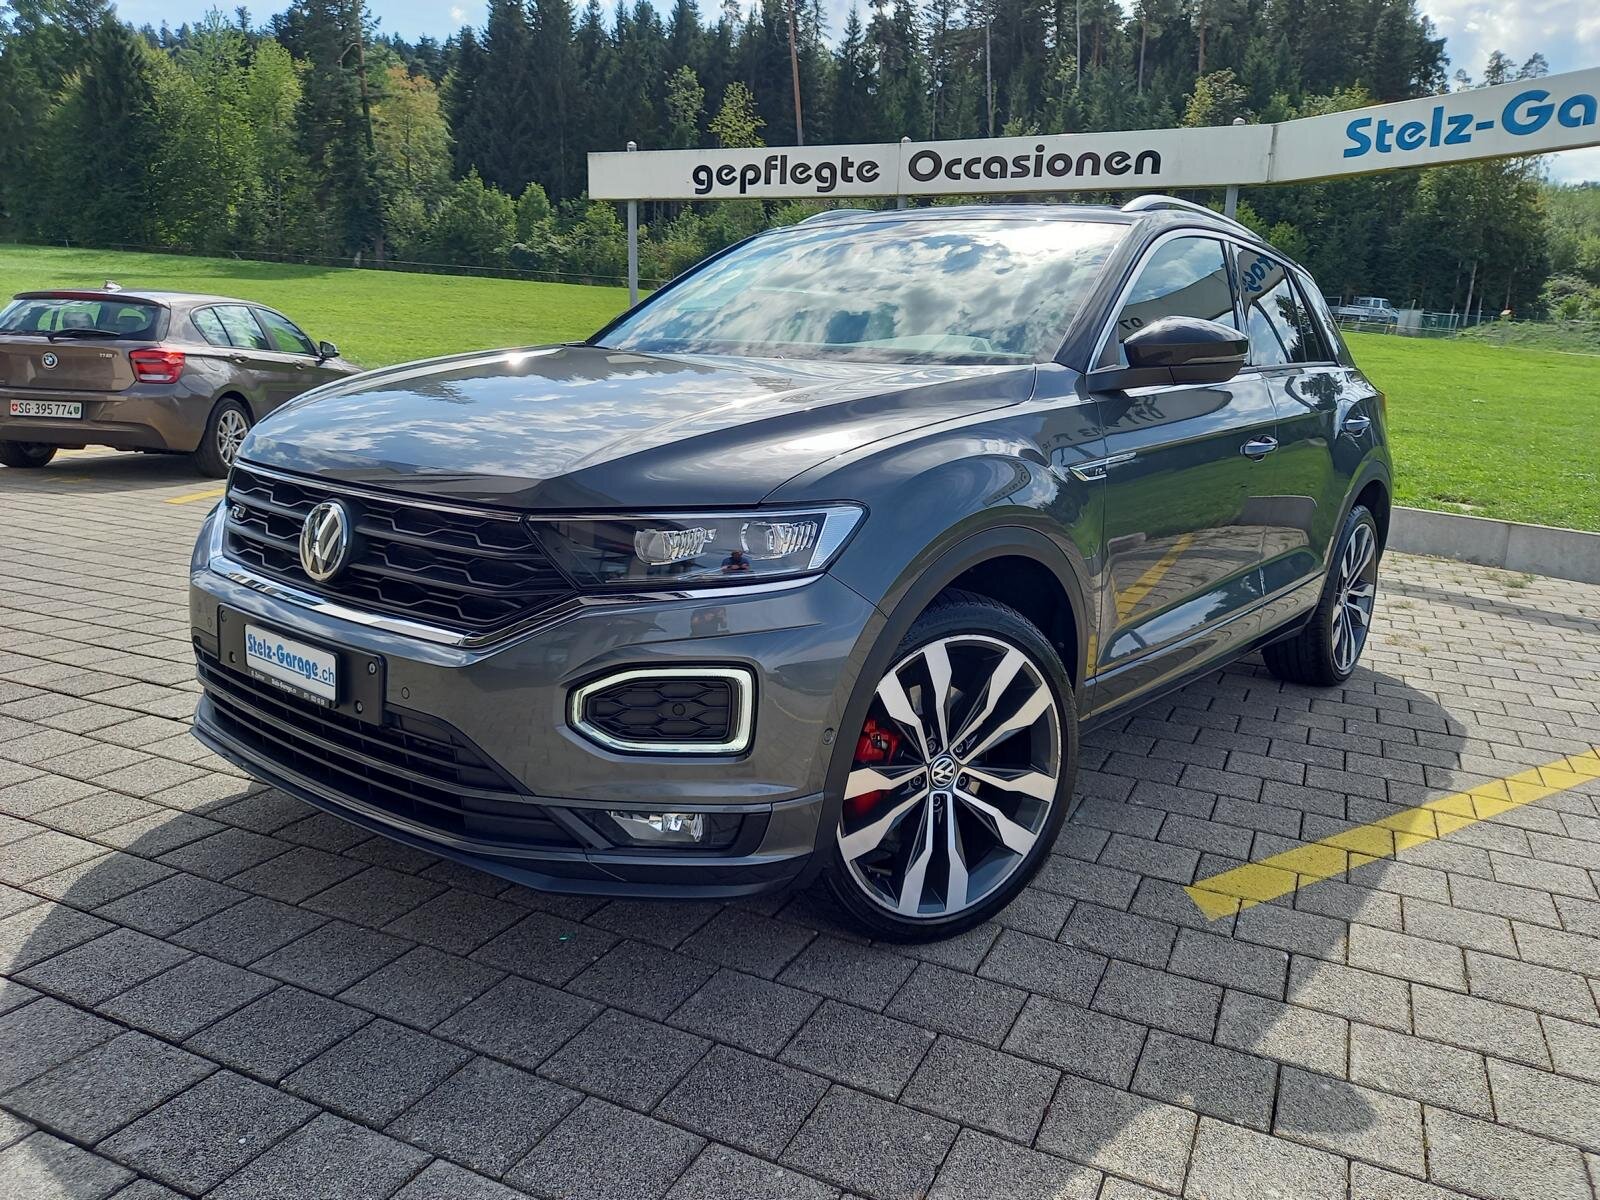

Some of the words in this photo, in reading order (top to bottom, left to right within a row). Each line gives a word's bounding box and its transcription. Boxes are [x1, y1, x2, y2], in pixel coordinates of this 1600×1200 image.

[692, 155, 880, 194] gepflegte
[908, 144, 1161, 182] Occasionen
[247, 633, 335, 684] Stelz-Garage.ch
